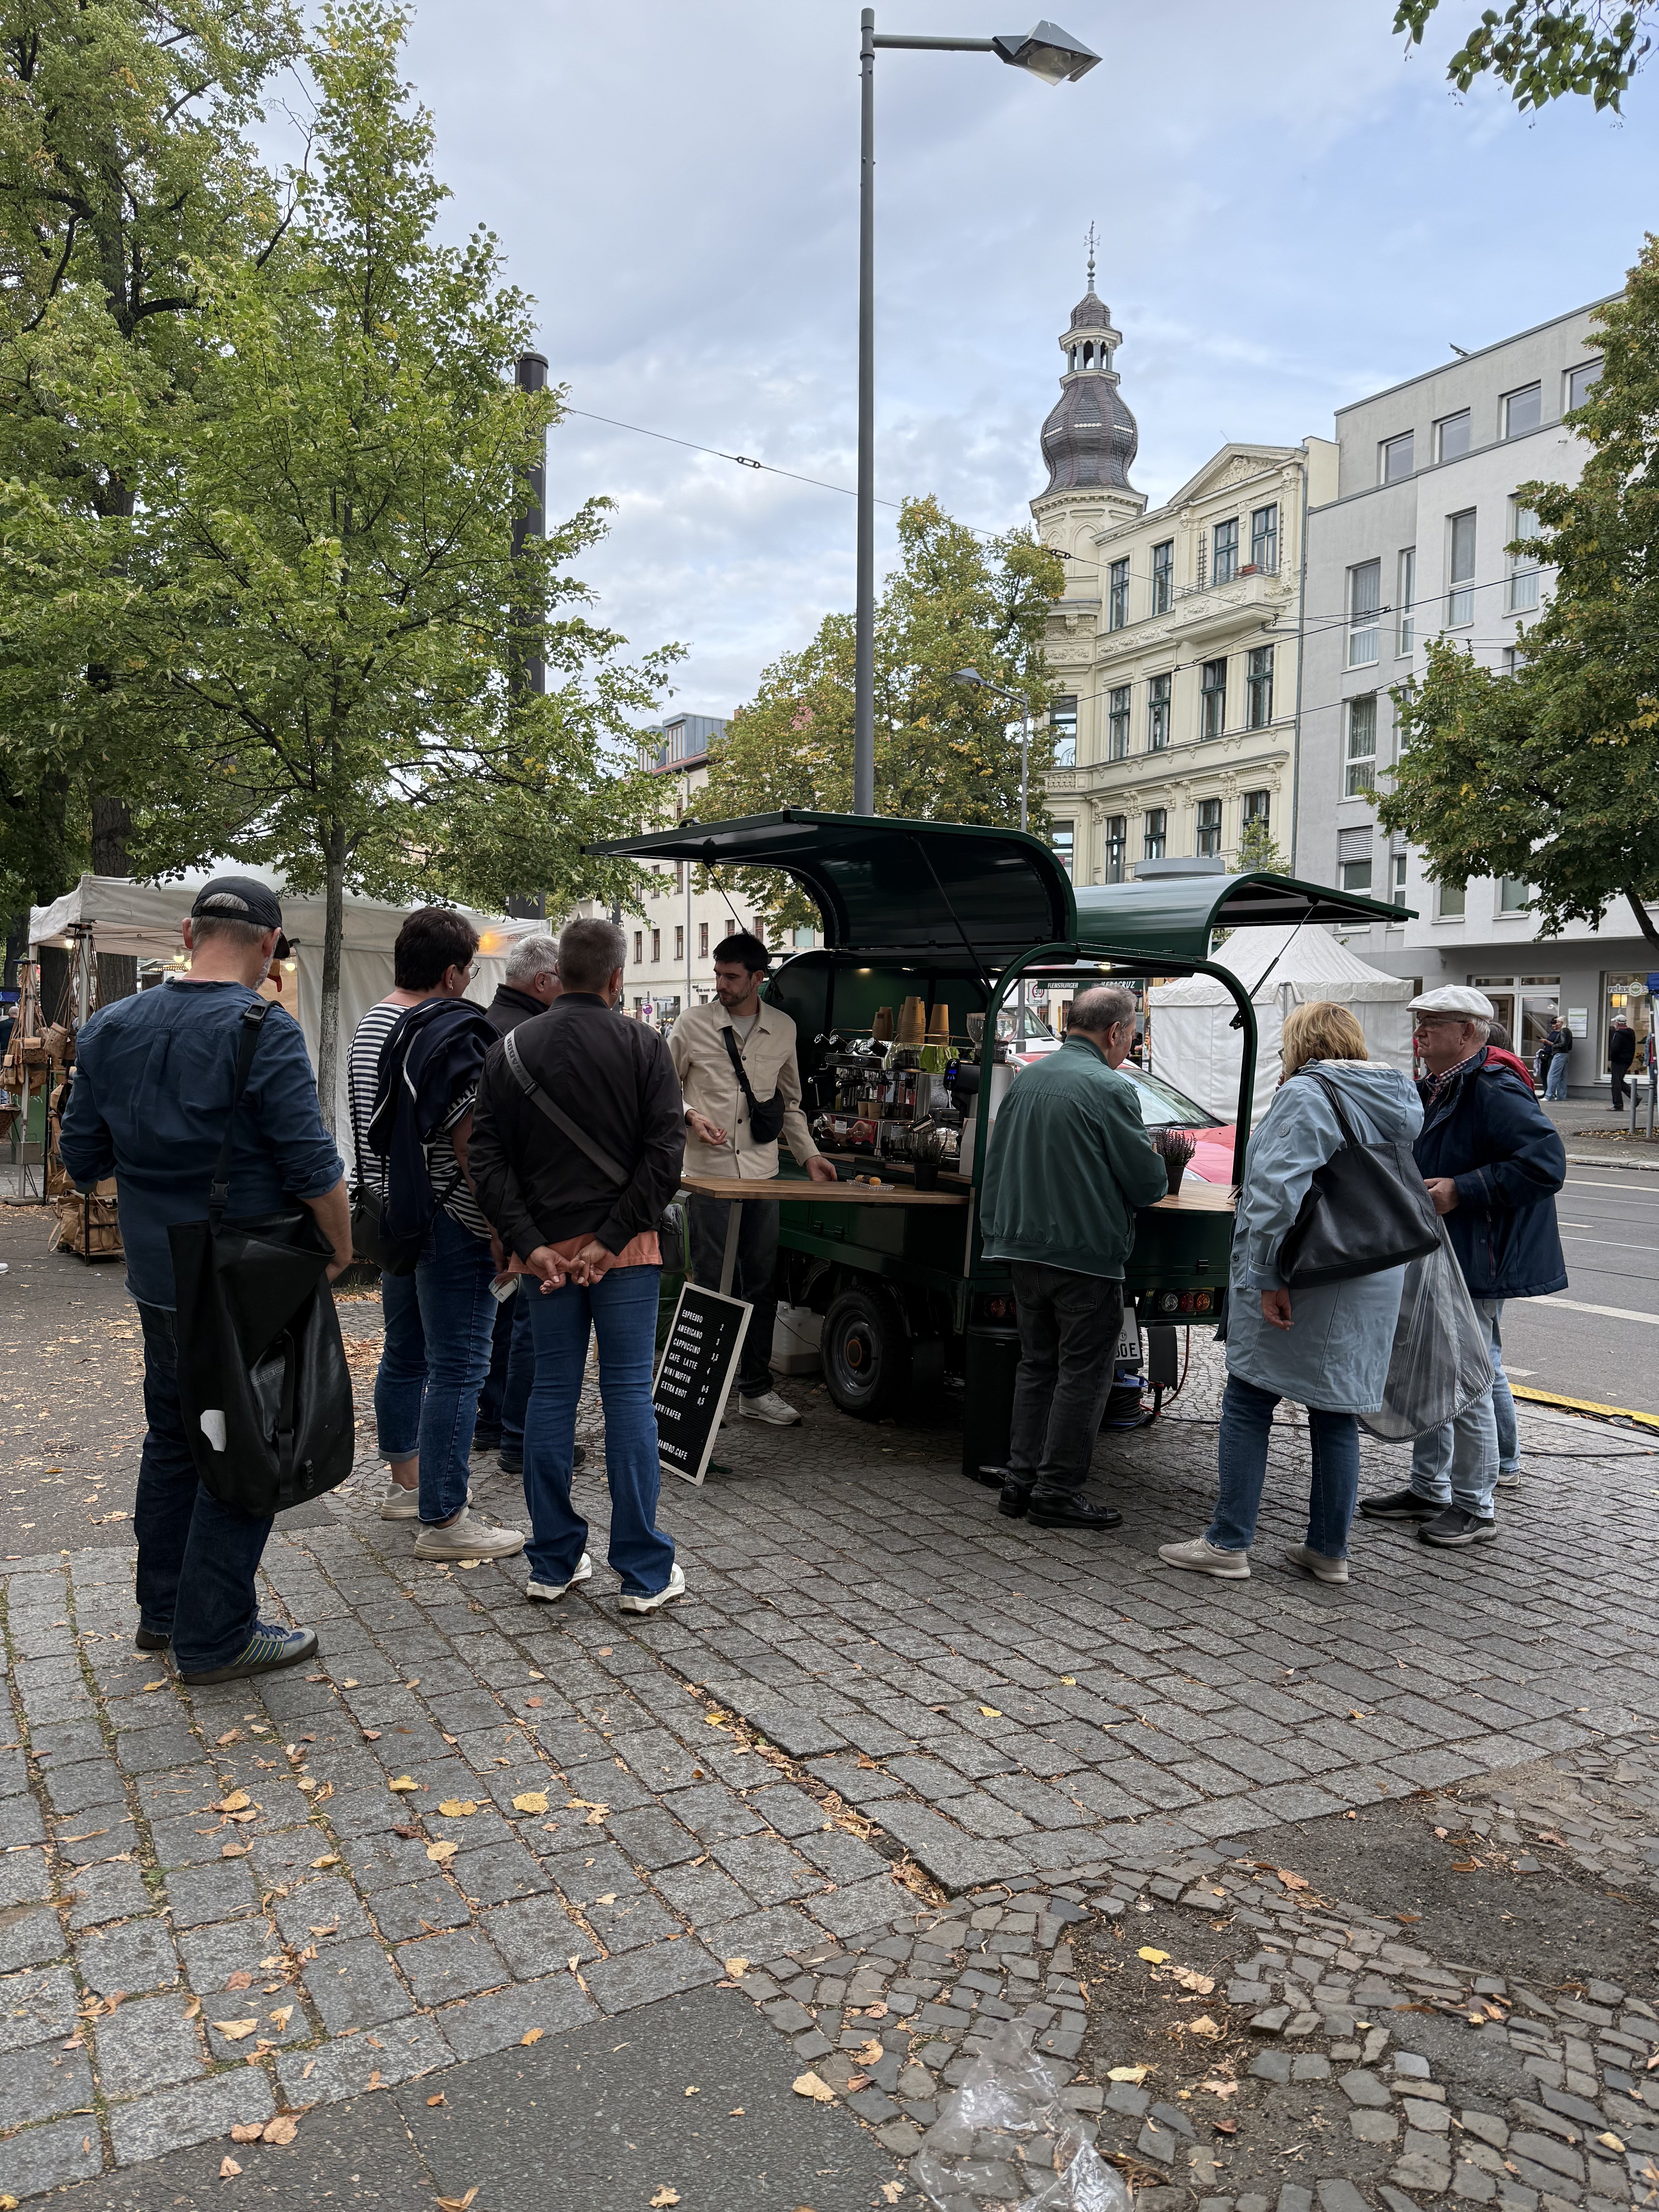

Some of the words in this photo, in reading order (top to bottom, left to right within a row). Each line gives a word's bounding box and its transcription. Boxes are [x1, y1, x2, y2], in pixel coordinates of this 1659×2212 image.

[682, 1310, 703, 1323] ESPRESSO
[677, 1324, 702, 1339] AMERICANO
[673, 1338, 700, 1354] CAPPUCCINO
[669, 1352, 680, 1362] CAFE
[683, 1358, 698, 1369] LATTE
[252, 1371, 273, 1383] ORTLIEB
[664, 1366, 675, 1377] MINI
[675, 1371, 691, 1384] MUFFIN
[661, 1381, 675, 1393] EXTRA
[675, 1388, 687, 1398] SHOT
[657, 1439, 688, 1460] SANDRO.CAFE
